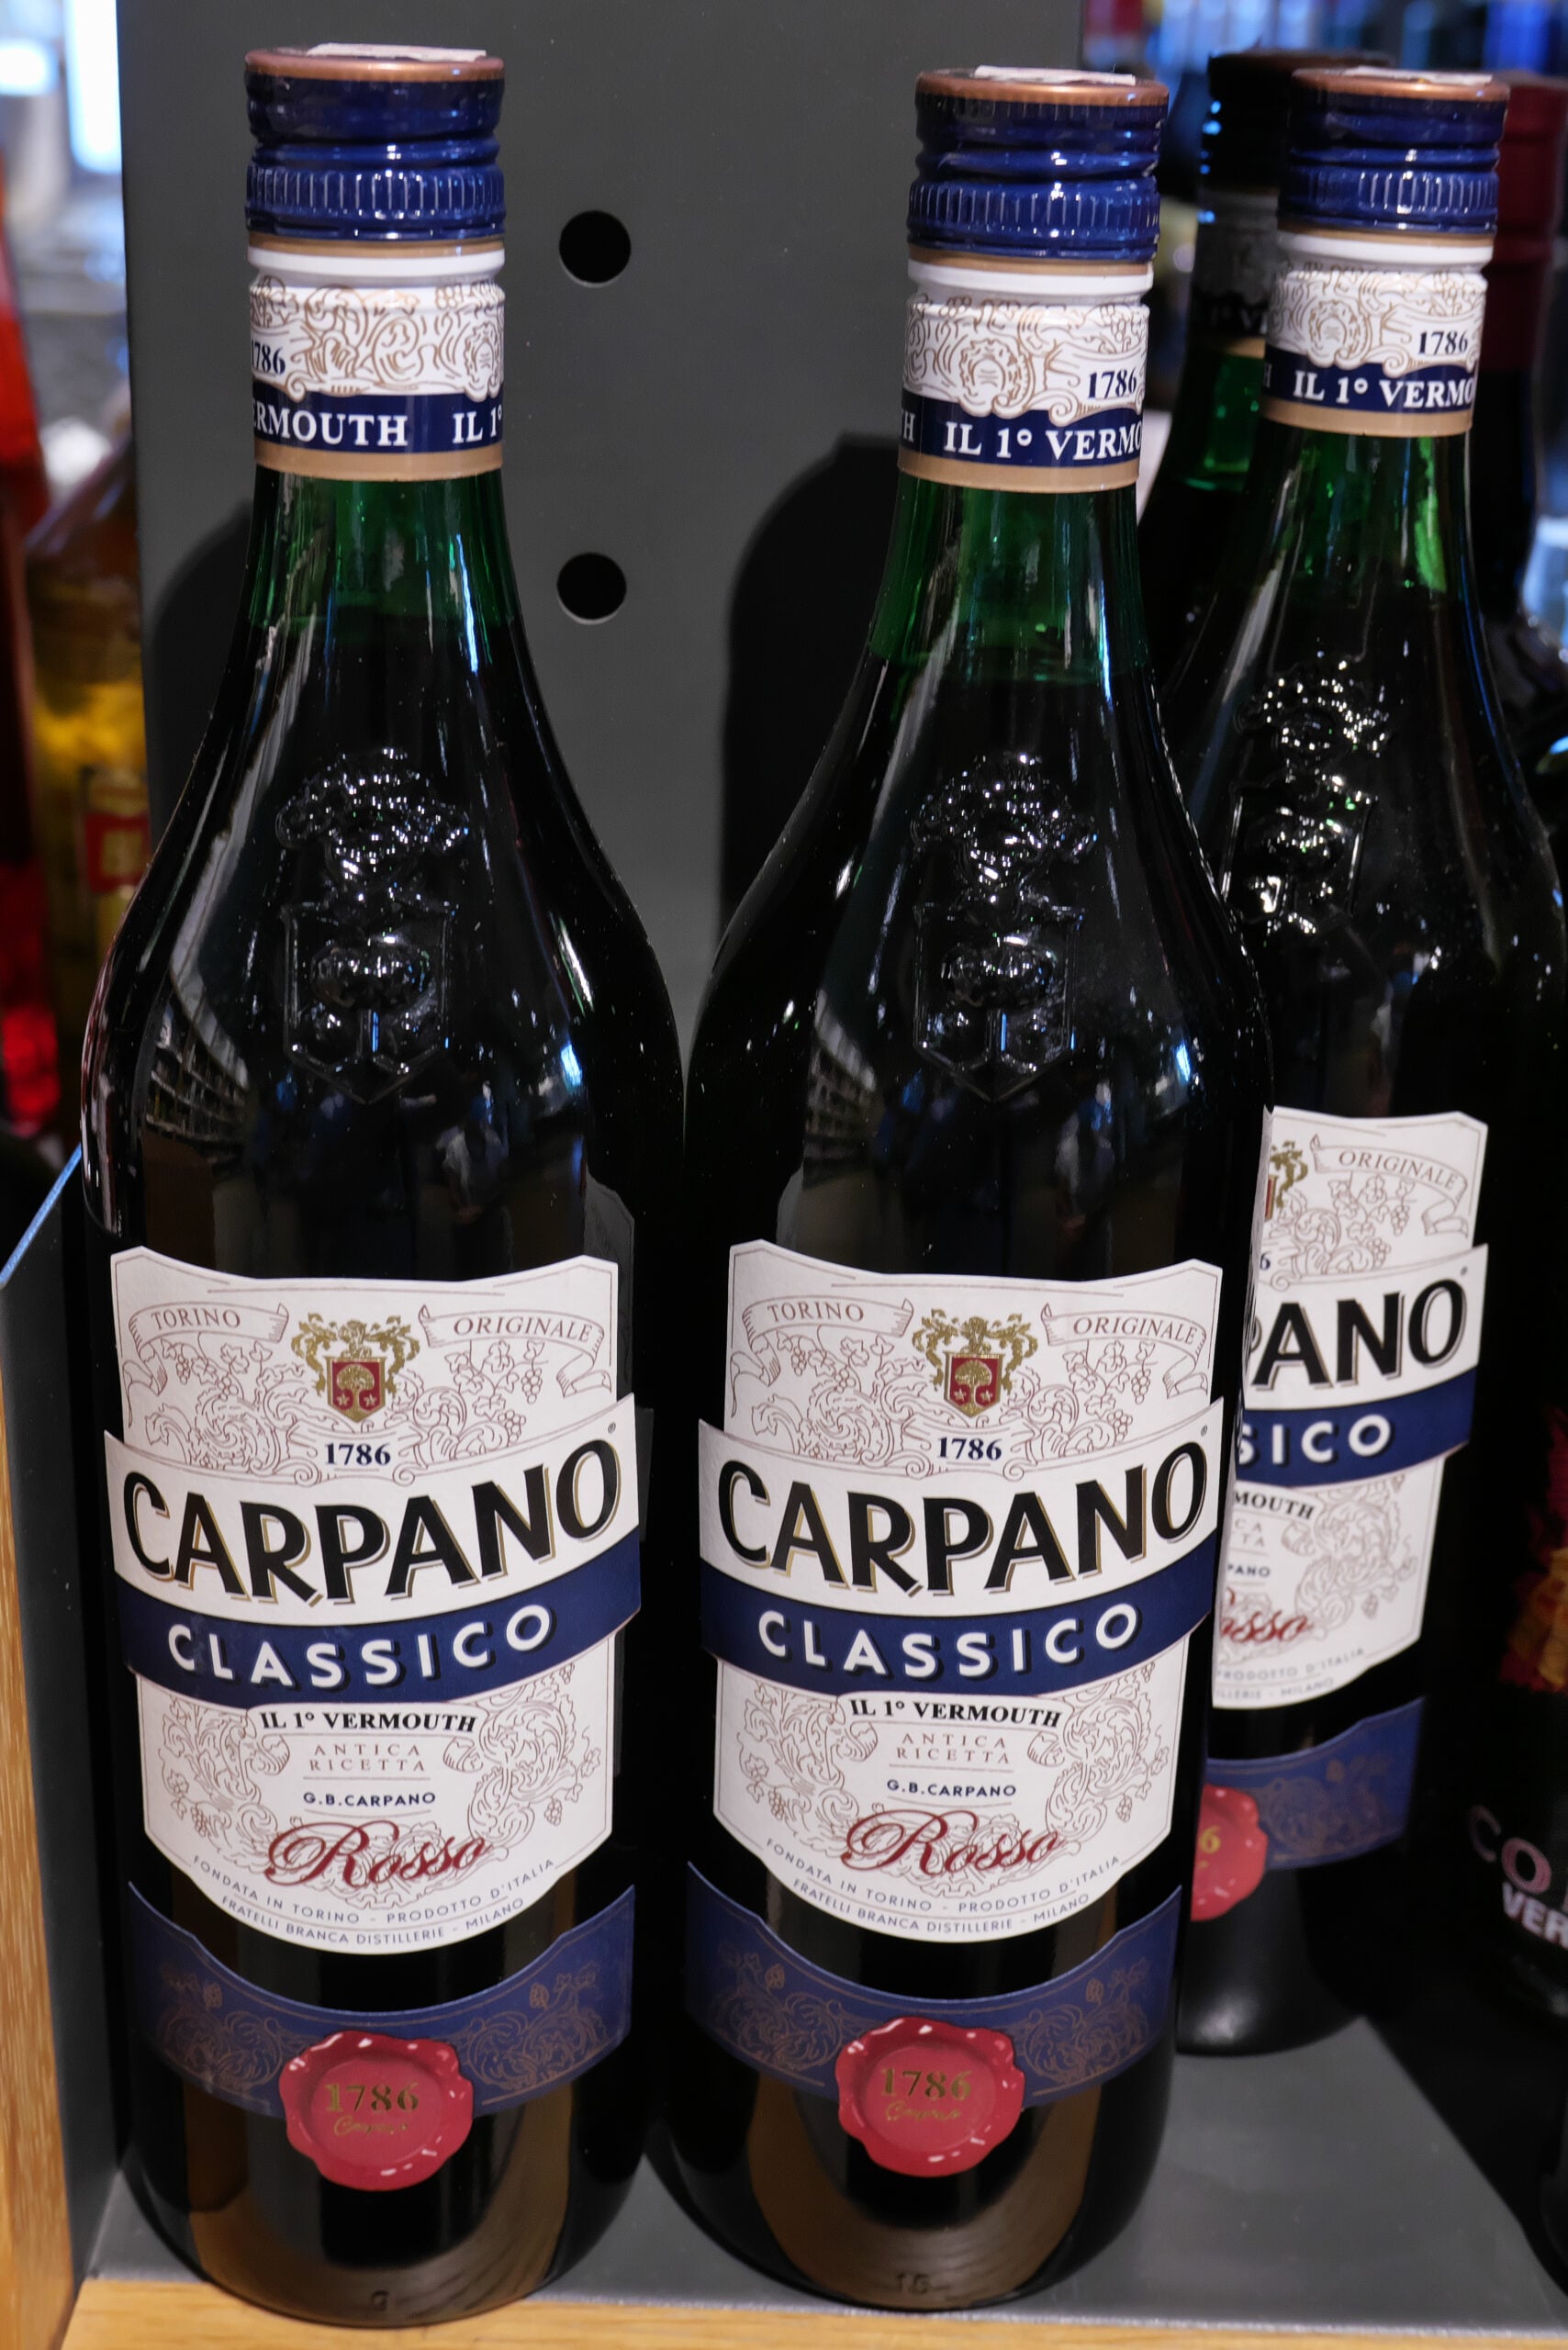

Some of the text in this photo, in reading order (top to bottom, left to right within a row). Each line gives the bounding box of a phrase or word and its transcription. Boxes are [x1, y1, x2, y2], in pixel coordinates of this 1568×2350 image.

[1418, 330, 1469, 355] 1786
[1088, 367, 1137, 399] 1786
[1293, 370, 1325, 401] IL
[452, 411, 484, 444] IL
[944, 420, 982, 456] IL
[1338, 1149, 1458, 1191] ORIGINALE
[151, 1308, 241, 1331] TORINO
[767, 1302, 864, 1323] TORINO
[453, 1315, 593, 1343] ORIGINALE
[1073, 1315, 1197, 1345] ORIGINALE
[1249, 1279, 1468, 1393] ANO
[324, 1441, 391, 1467] 1786
[937, 1436, 1002, 1461] 1786
[122, 1438, 622, 1607] CARPANO
[718, 1441, 1209, 1597] CARPANO
[168, 1604, 555, 1691] CLASSICO
[758, 1603, 1139, 1680] CLASSICO
[260, 1712, 286, 1729] IL
[323, 1713, 478, 1733] VERMOUTH
[849, 1698, 876, 1716] IL
[913, 1702, 1063, 1729] VERMOUTH
[314, 1744, 420, 1757] ANTICA
[896, 1747, 1010, 1764] RICETTA
[902, 1732, 1007, 1749] ANTICA
[309, 1759, 425, 1772] RICETTA
[264, 1819, 492, 1889] Rosso
[841, 1809, 1062, 1876] Rosso
[194, 1855, 258, 1901] FONDATA
[267, 1895, 283, 1910] IN
[293, 1904, 359, 1924] TORINO
[386, 1897, 482, 1924] PRODOTTO
[490, 1859, 554, 1899] D'ITALIA
[767, 1838, 832, 1885] FONDATA
[840, 1880, 857, 1894] IN
[867, 1888, 932, 1911] TORINO
[958, 1888, 1050, 1912] PRODOTTO
[1058, 1855, 1120, 1894] D'ITALIA
[222, 1895, 279, 1930] FRATELLI
[286, 1923, 349, 1944] BRANCA
[356, 1927, 444, 1945] DISTILLERIE
[465, 1898, 524, 1930] MILANO
[793, 1878, 850, 1913] FRATELLI
[857, 1908, 920, 1930] BRANCA
[926, 1918, 1013, 1933] DISTILLERIE
[1034, 1894, 1090, 1922] MILANO
[324, 2081, 419, 2113] 1786
[880, 2067, 972, 2101] 1786
